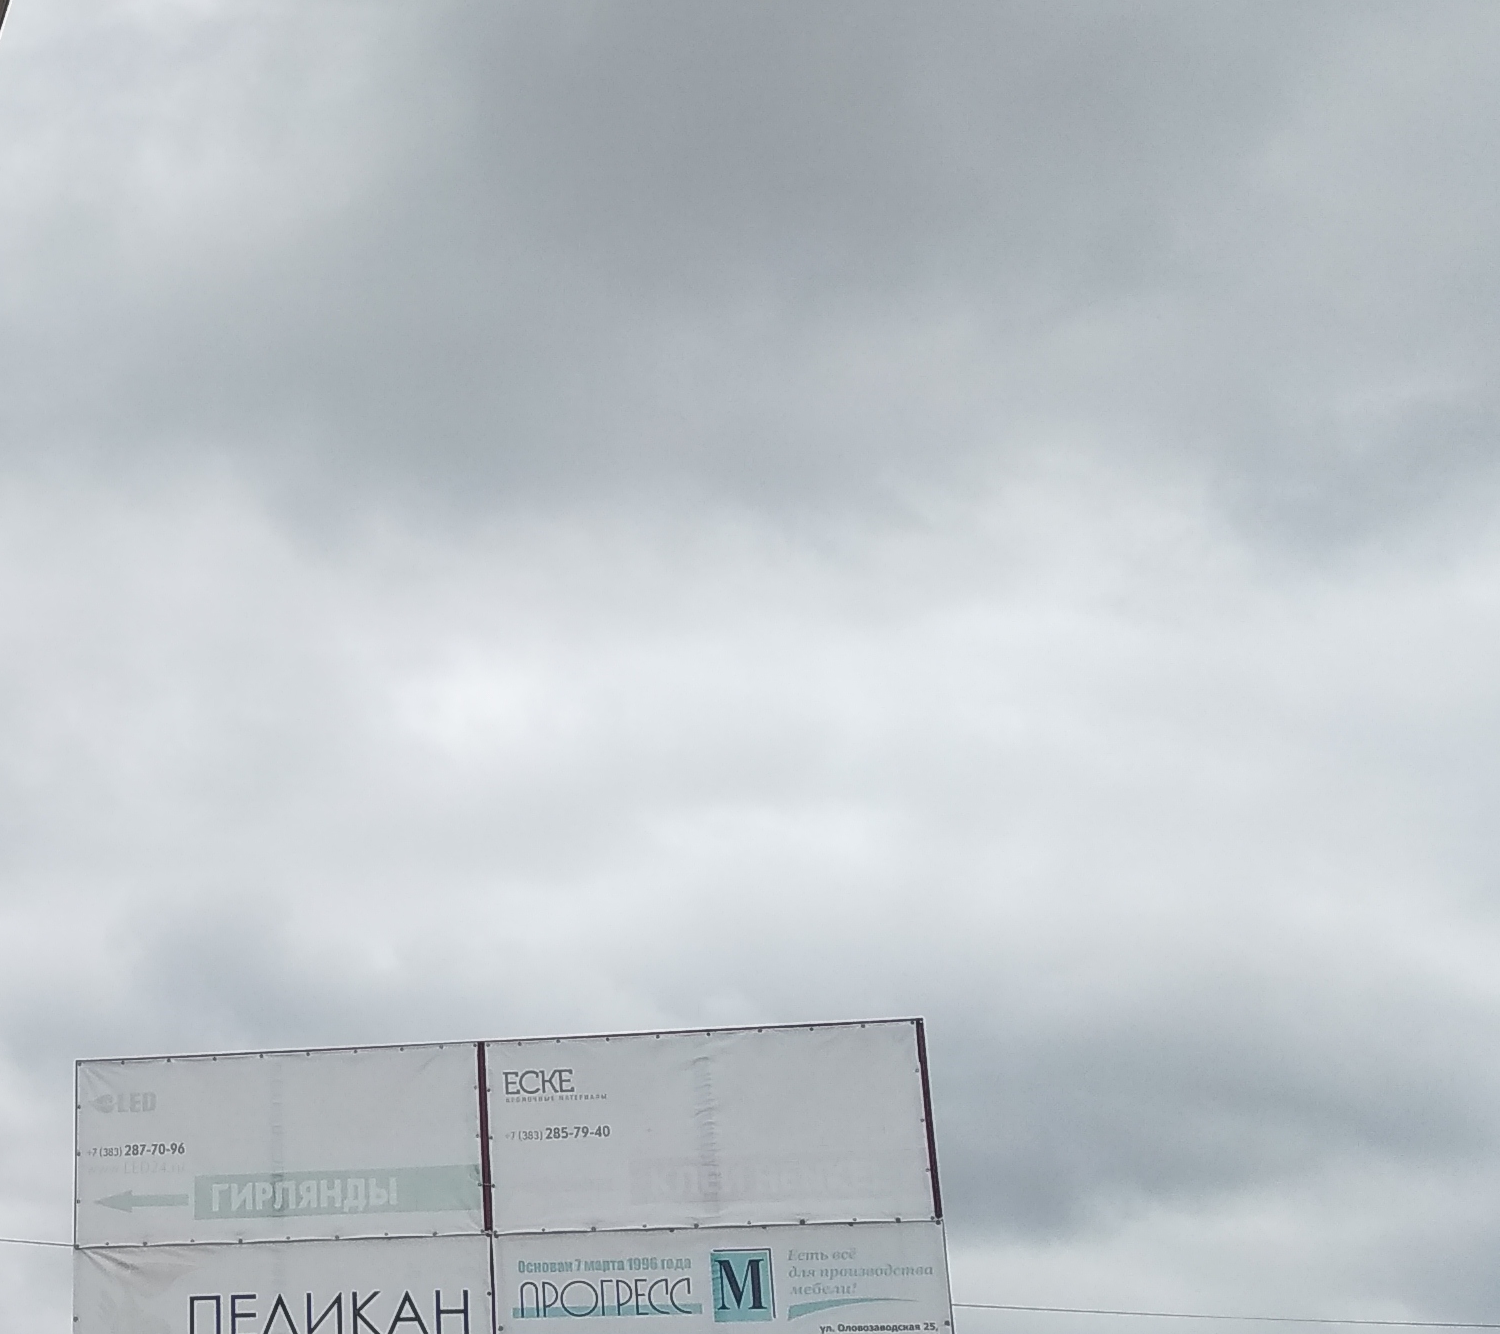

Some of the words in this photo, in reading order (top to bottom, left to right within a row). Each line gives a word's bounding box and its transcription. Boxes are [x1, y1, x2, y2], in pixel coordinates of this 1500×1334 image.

[502, 1068, 575, 1095] ECKE
[545, 1125, 611, 1140] 285-79-40
[99, 1147, 122, 1158] (383)
[124, 1142, 186, 1157] 287-70-96
[211, 1176, 399, 1213] ГИРЛЯНДЫ
[517, 1259, 573, 1274] Основан
[574, 1258, 582, 1272] 7
[583, 1258, 625, 1273] марта
[626, 1256, 658, 1272] 1996
[660, 1257, 692, 1272] года
[519, 1276, 693, 1318] ПРОГРЕСС
[819, 1324, 835, 1334] ул.
[837, 1322, 921, 1334] Оловозаводская
[923, 1322, 939, 1332] 25,
